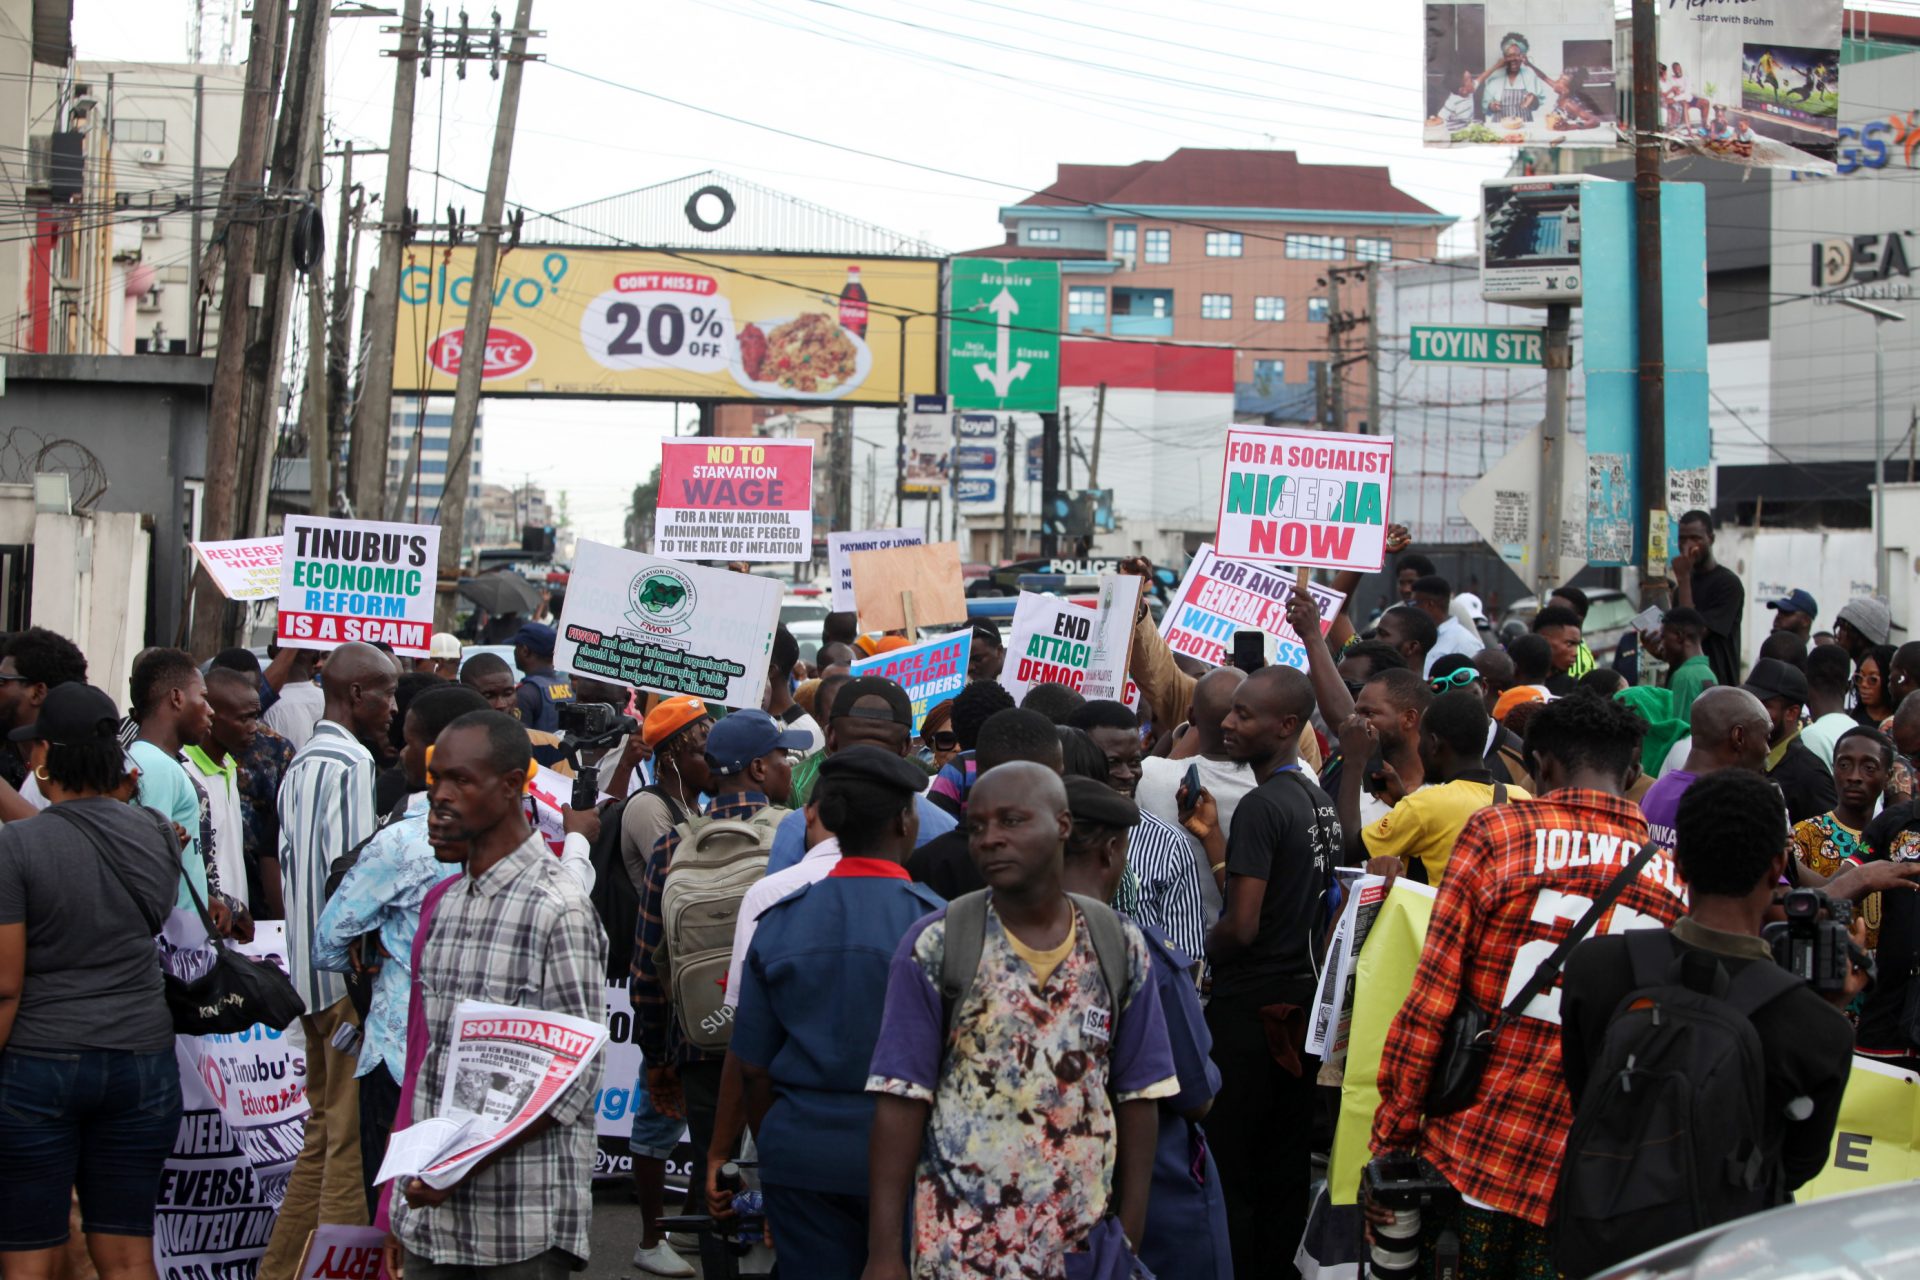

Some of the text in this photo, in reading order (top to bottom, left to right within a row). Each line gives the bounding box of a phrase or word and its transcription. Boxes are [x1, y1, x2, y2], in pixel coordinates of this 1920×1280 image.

[1721, 15, 1741, 24] with
[1743, 17, 1774, 27] Brühm
[1811, 233, 1910, 288] IDEA
[619, 276, 709, 292] DON'T MISS IT
[689, 341, 721, 358] OFF
[1415, 330, 1542, 361] TOYIN STR
[707, 446, 765, 464] NO TO
[1229, 441, 1390, 473] FOR A SOCIALIST
[692, 465, 777, 479] STARVATION
[682, 479, 784, 507] WAGE
[1226, 471, 1382, 525] NIGERIA
[675, 510, 791, 525] FOR A NEW NATIONAL
[294, 526, 427, 566] TINUBU'S
[664, 525, 801, 539] MINIMUM WAGE PEGGED
[840, 538, 921, 552] PAYMENT OF LIVING
[1249, 519, 1356, 560] NOW
[660, 540, 803, 554] TO THE RATE OF INFLATION
[224, 557, 282, 568] HIKE
[1050, 559, 1118, 574] POLICE
[1210, 560, 1246, 585] FOR
[293, 561, 421, 596] ECONOMIC
[632, 569, 665, 592] FEDERATION
[675, 573, 693, 601] INFORMAL
[305, 590, 406, 618] REFORM
[1197, 579, 1267, 627] GENERAL
[285, 614, 424, 646] IS A SCAM
[640, 621, 672, 634] FIWON
[1053, 612, 1091, 641] END
[567, 626, 743, 675] FIWON and other informal organizations
[579, 644, 727, 685] should be part of Managing Public
[928, 643, 962, 666] ALL
[575, 656, 726, 697] Resources budgeted for Palliatives
[463, 1020, 592, 1056] SOLIDARITY
[230, 1053, 306, 1083] Tinubu's
[480, 1053, 530, 1068] AFFORDABLE!
